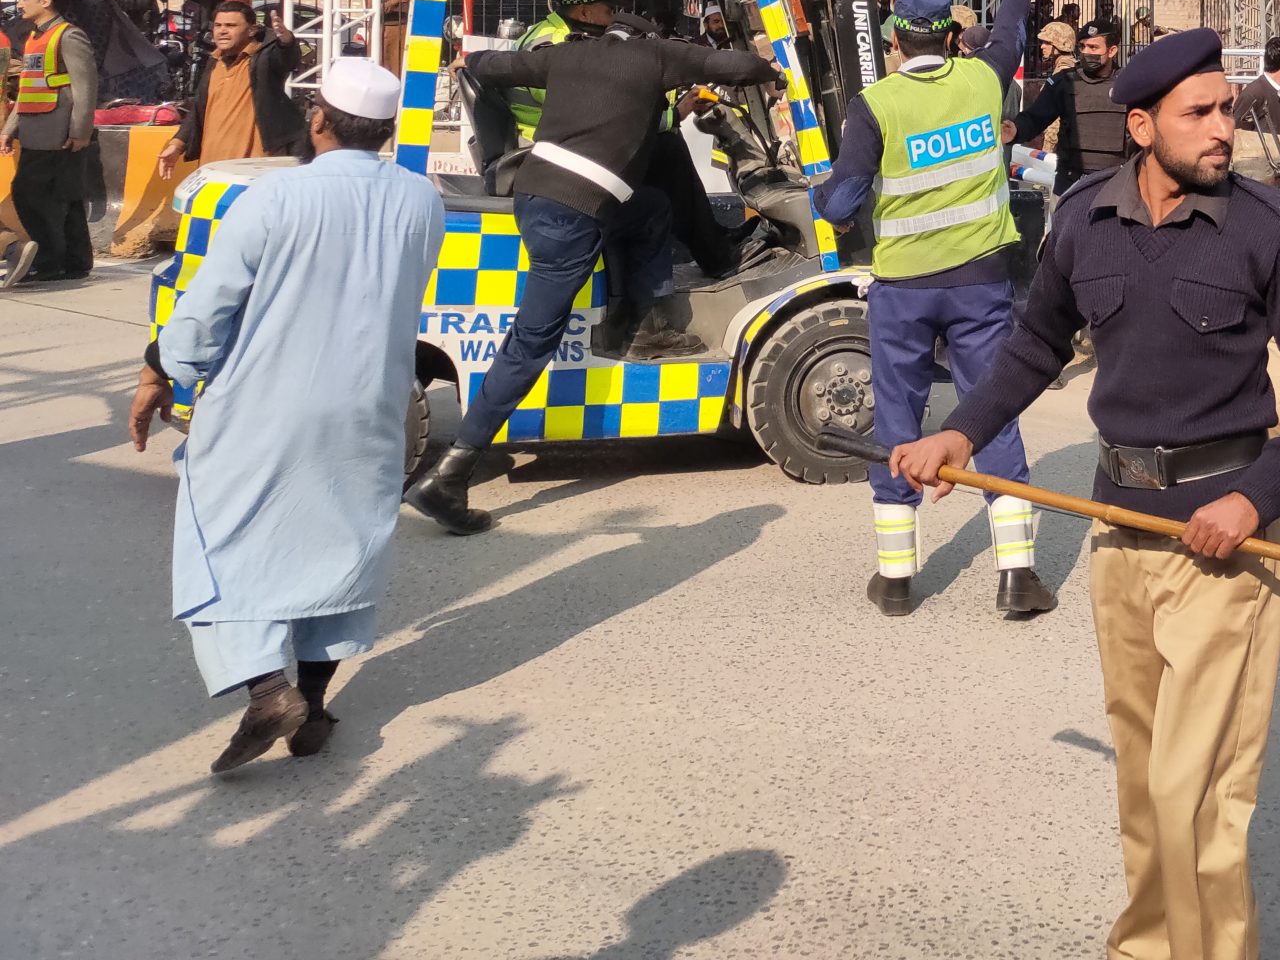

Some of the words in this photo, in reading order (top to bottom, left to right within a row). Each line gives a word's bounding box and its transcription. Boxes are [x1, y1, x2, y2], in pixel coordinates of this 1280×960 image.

[910, 118, 993, 163] POLICE
[418, 312, 586, 335] TRAFC
[460, 340, 585, 362] WANS
